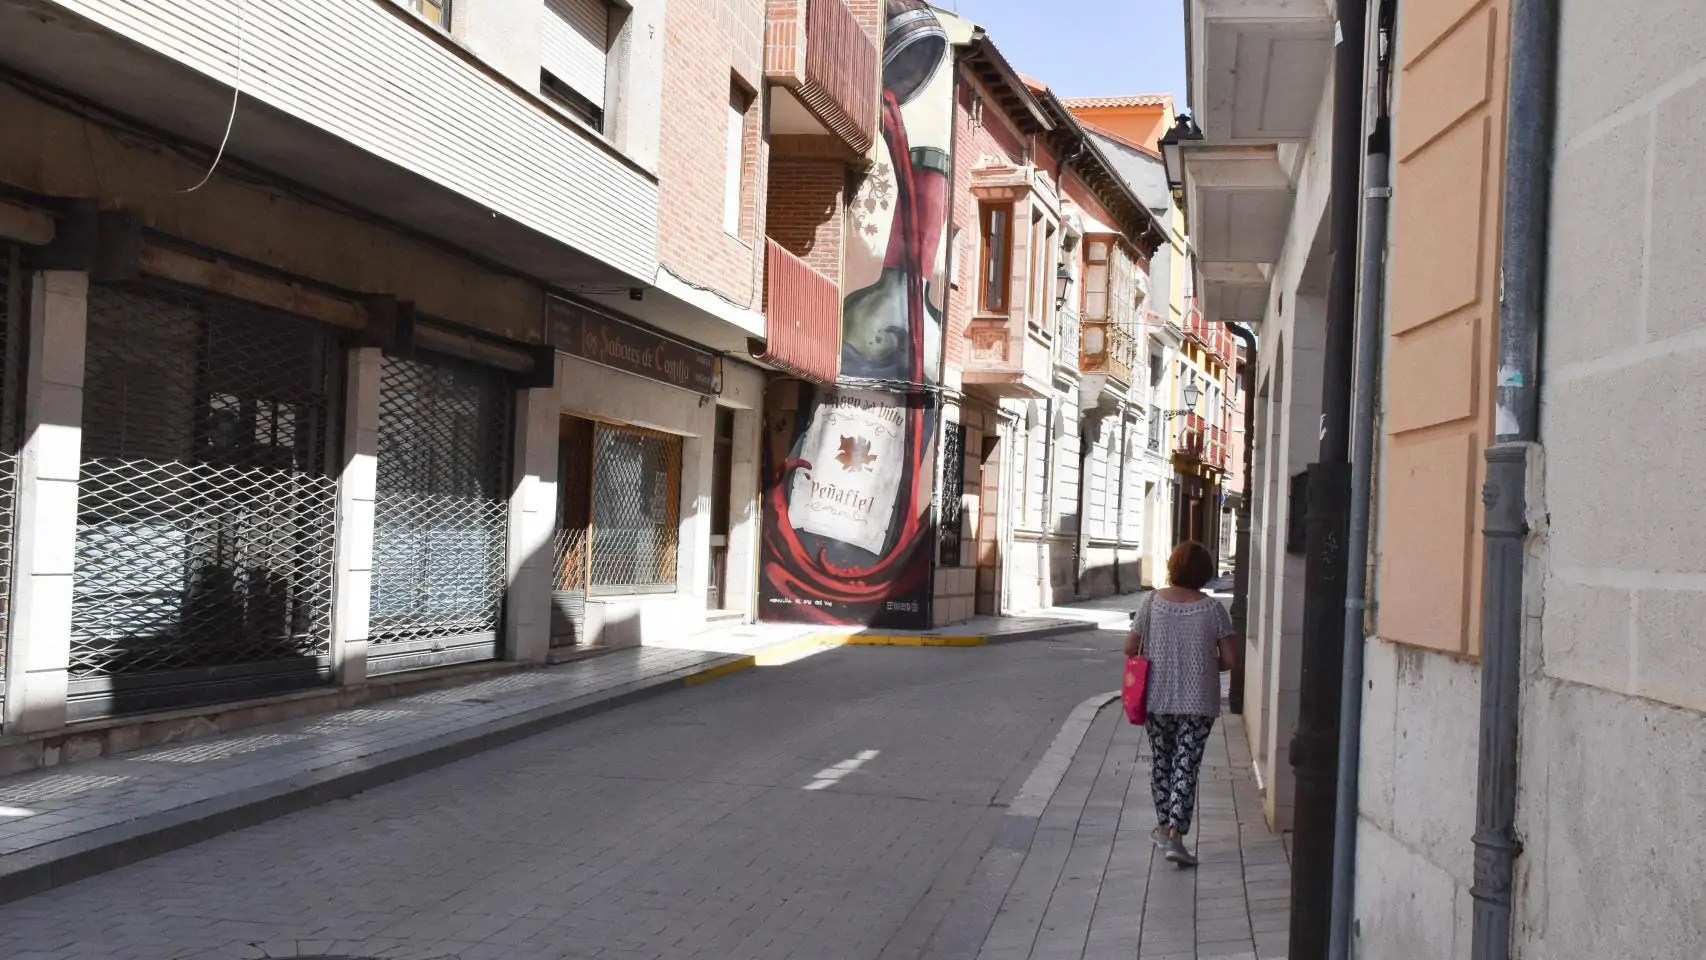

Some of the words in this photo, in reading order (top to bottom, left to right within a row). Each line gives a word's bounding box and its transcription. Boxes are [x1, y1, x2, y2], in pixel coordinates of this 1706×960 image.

[600, 325, 641, 367] Sabores
[642, 349, 652, 367] de
[655, 341, 690, 382] Castilla
[811, 481, 875, 514] Peñafiel
